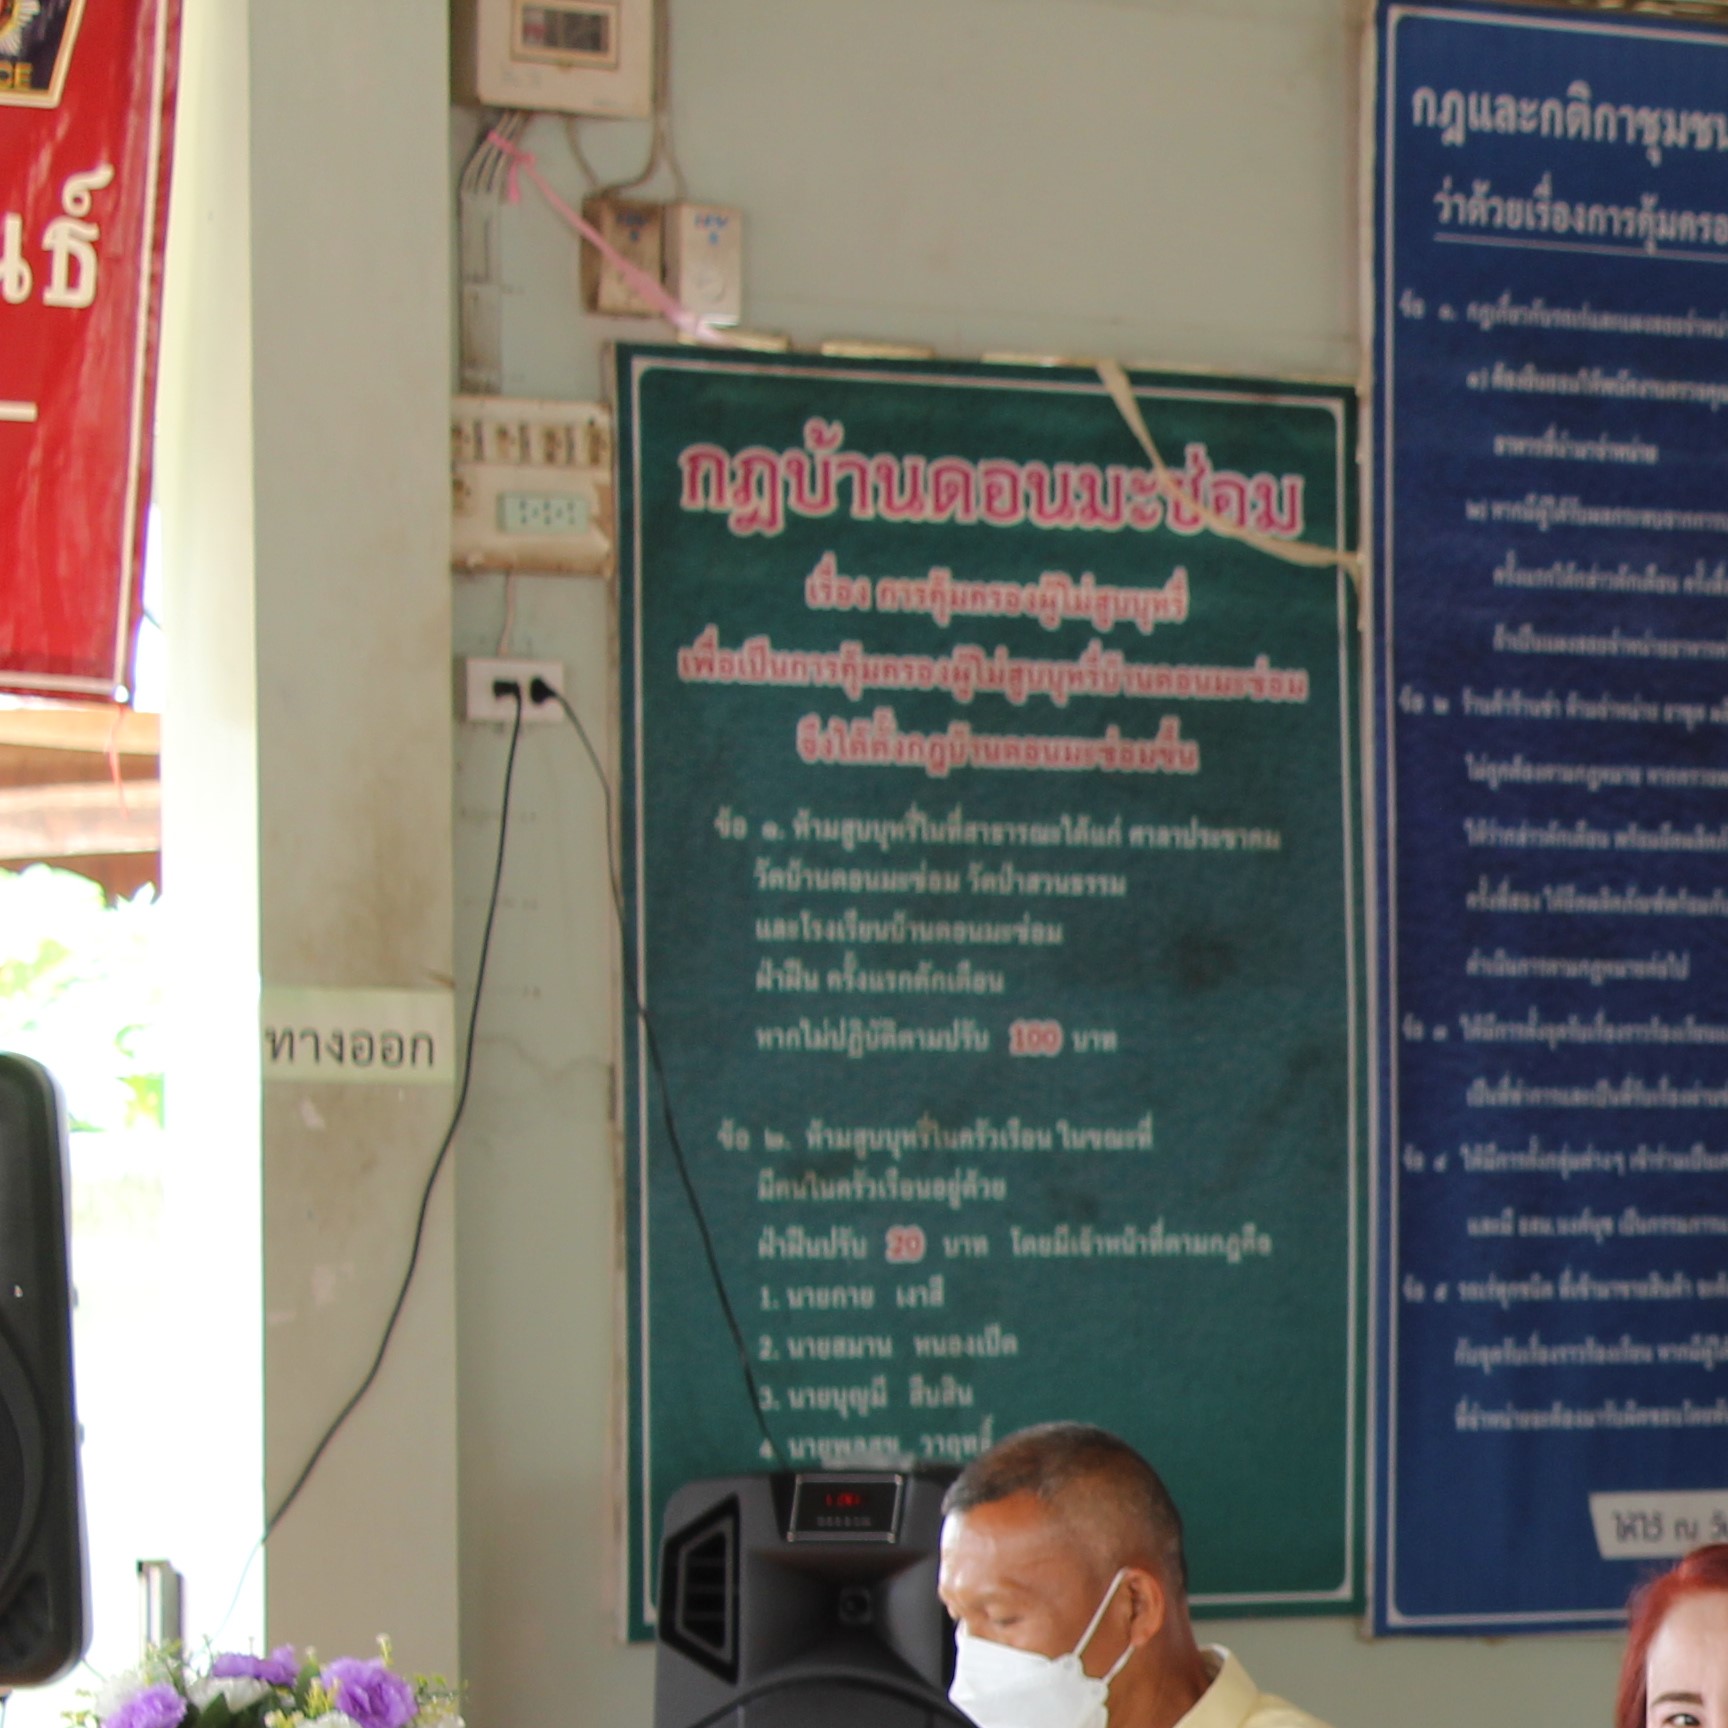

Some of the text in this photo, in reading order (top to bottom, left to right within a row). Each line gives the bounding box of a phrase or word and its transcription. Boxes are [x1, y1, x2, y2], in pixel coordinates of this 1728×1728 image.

[265, 1026, 435, 1069] ทางออก
[1009, 1019, 1063, 1057] 100
